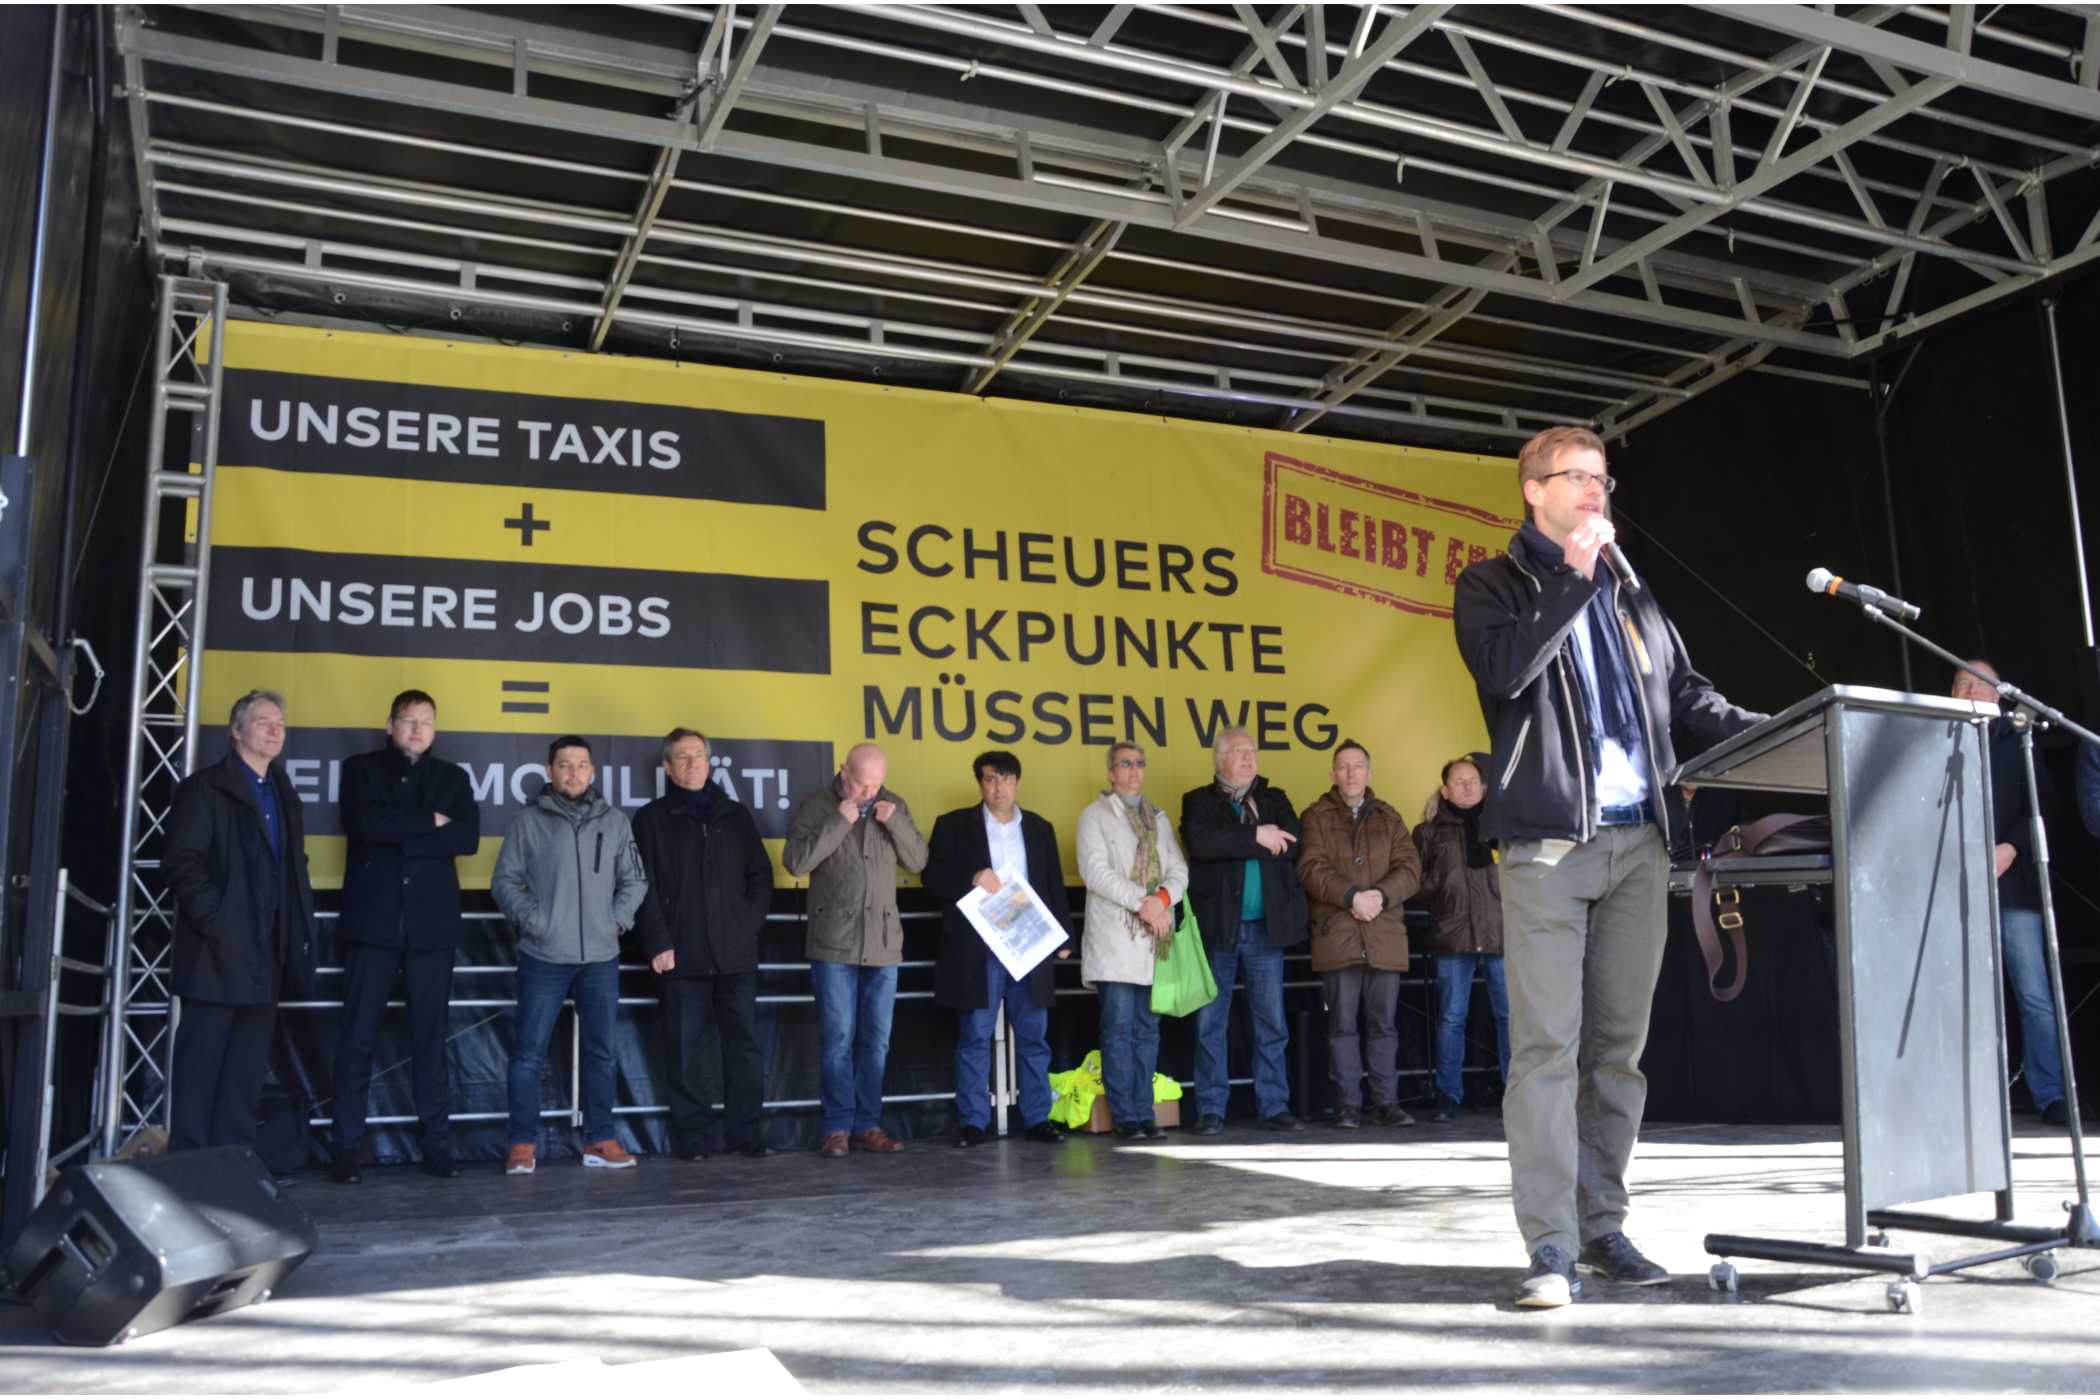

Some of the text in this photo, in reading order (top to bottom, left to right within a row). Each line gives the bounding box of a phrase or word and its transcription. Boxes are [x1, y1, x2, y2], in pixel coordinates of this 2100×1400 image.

[250, 399, 681, 470] UNSERE TAXIS
[857, 520, 1239, 597] SCHEUERS
[1284, 493, 1436, 578] BLEIBT
[241, 577, 671, 638] UNSERE JOBS
[861, 601, 1286, 675] ECKPUNKTE
[863, 672, 1167, 748] MÜSSEN
[456, 755, 790, 810] MOILIÄT!
